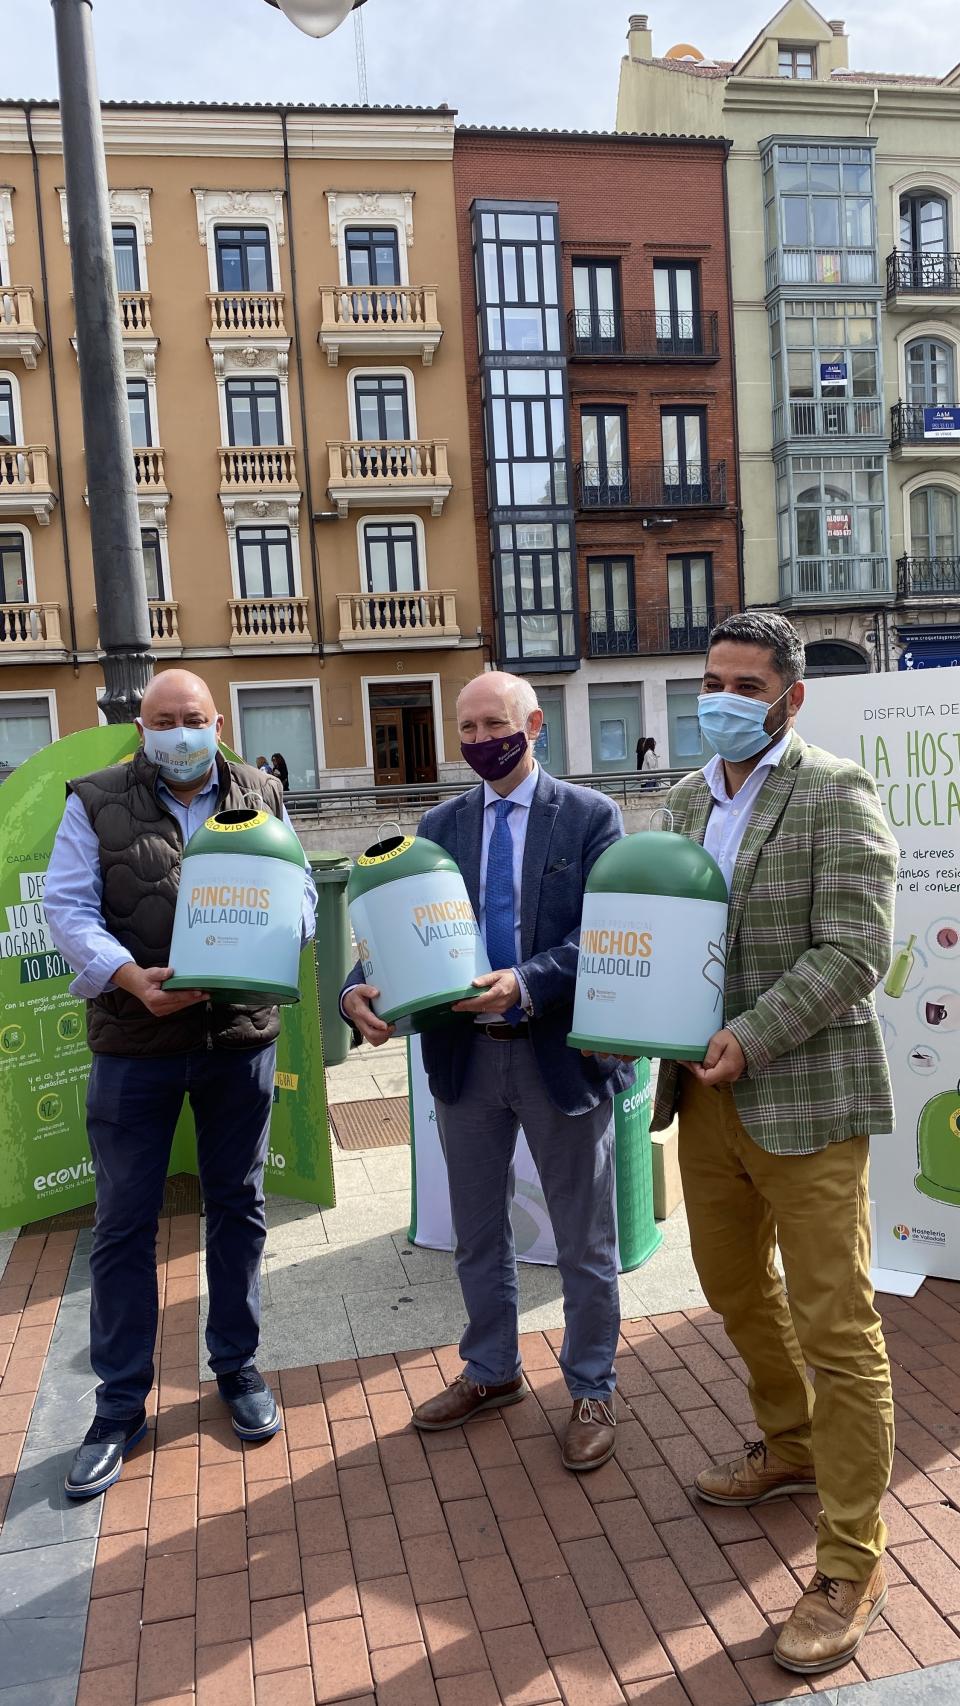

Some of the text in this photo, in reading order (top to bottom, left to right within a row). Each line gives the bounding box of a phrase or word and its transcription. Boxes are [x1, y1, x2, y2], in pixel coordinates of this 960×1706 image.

[864, 703, 960, 721] DISFRUTA DE
[224, 820, 260, 831] VIDRIO
[7, 856, 32, 864] CADA
[380, 840, 411, 861] VIDRIO
[912, 848, 954, 858] atreves
[191, 886, 270, 909] PINCHOS
[910, 882, 919, 892] el
[13, 905, 27, 929] LO
[188, 903, 269, 928] VALLADOLID
[412, 923, 480, 946] VALLADOL
[24, 954, 74, 982] 10 BOT
[579, 956, 650, 978] ALLADOLID
[37, 1186, 64, 1200] ENTIDAD
